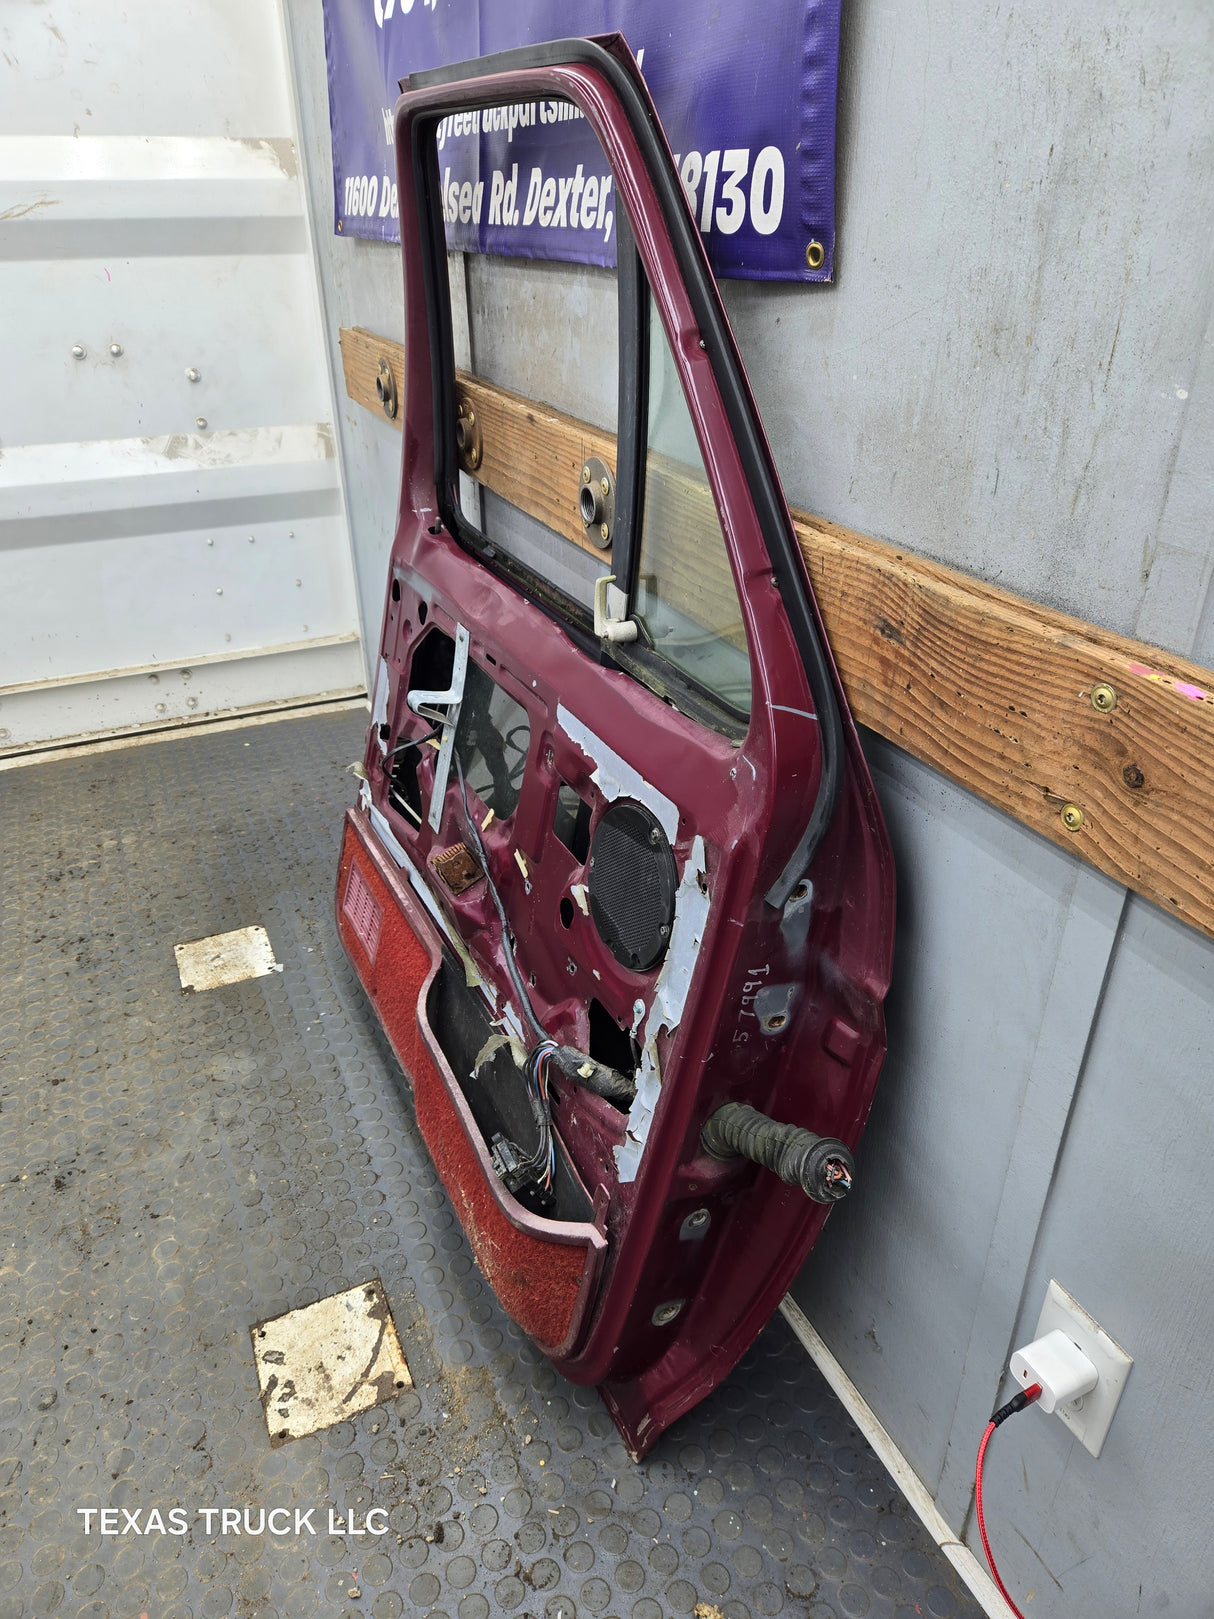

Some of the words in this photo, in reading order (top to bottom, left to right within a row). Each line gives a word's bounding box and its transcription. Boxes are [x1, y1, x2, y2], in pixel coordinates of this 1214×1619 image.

[344, 175, 379, 217] 11600
[379, 175, 399, 219] De
[441, 167, 484, 224] lsea
[488, 163, 520, 226] Rd.
[523, 163, 614, 242] Dexter,
[674, 146, 785, 235] 8130
